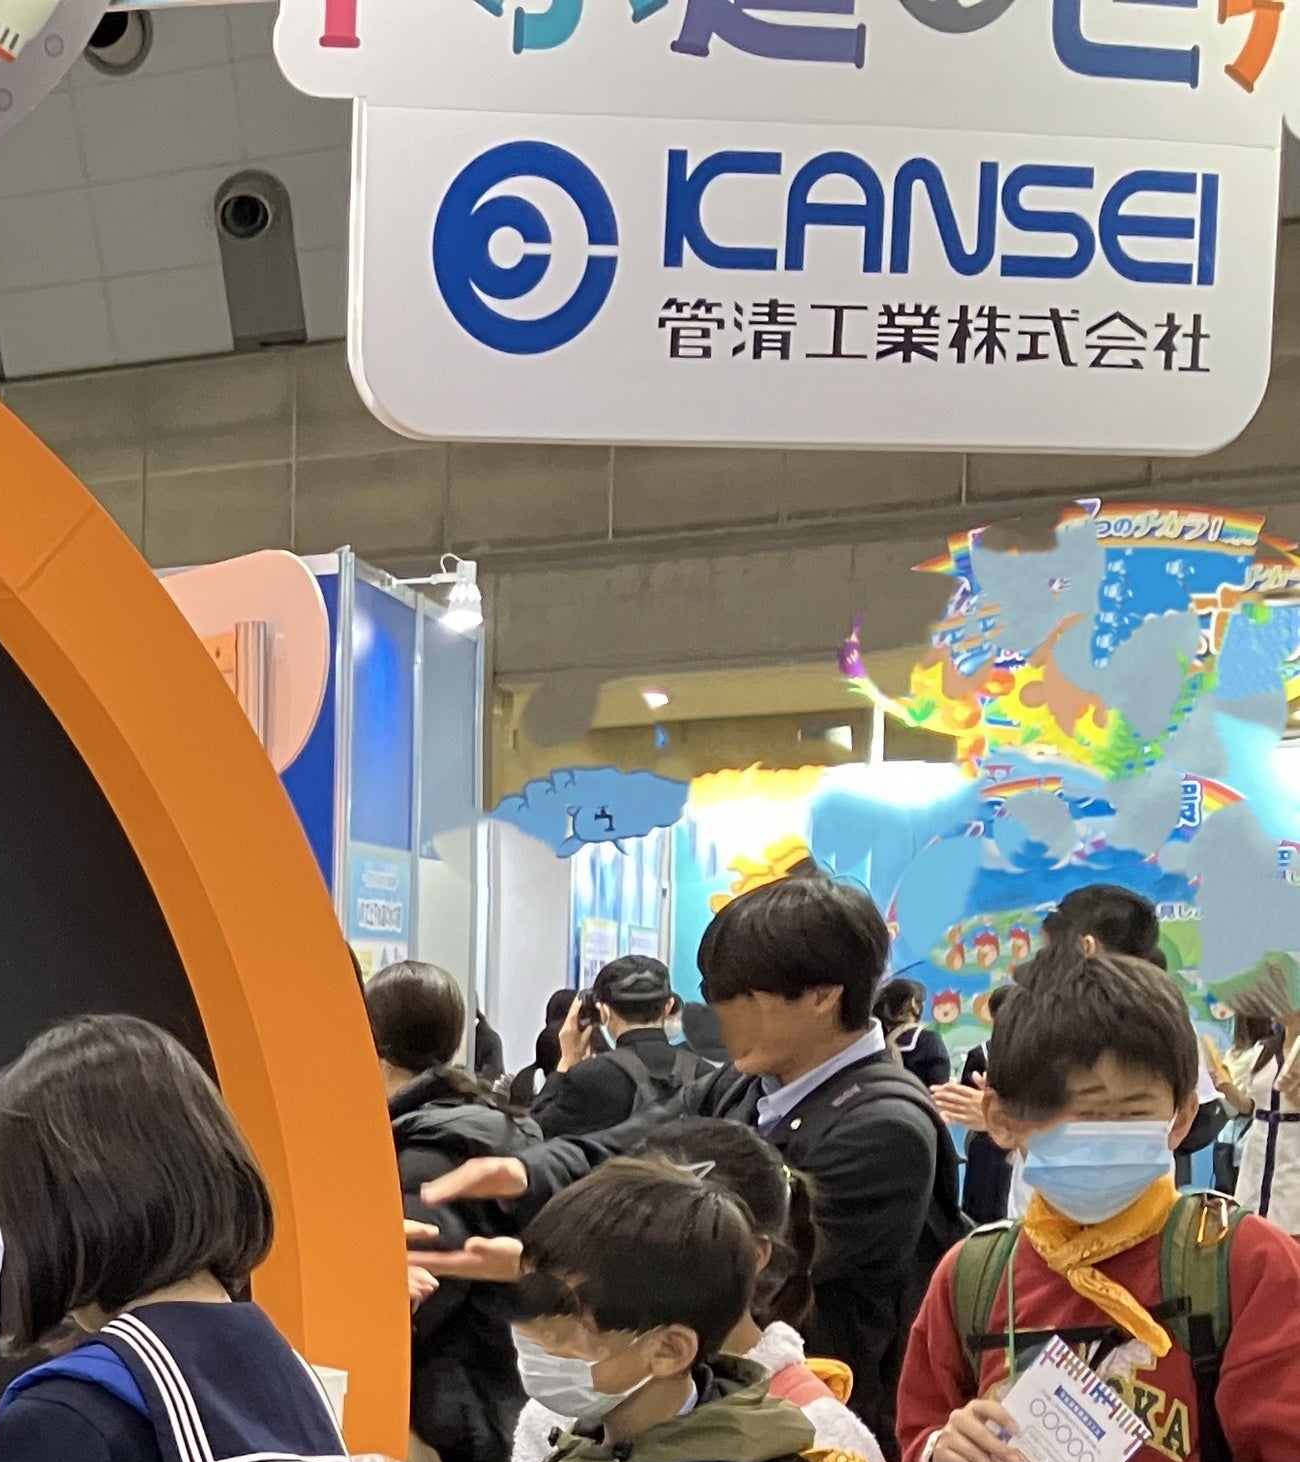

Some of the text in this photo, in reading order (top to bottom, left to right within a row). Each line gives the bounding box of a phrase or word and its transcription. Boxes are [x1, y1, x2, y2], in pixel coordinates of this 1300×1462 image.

[663, 148, 1220, 286] KANSEI
[657, 298, 1211, 373] 管清工業株式会社
